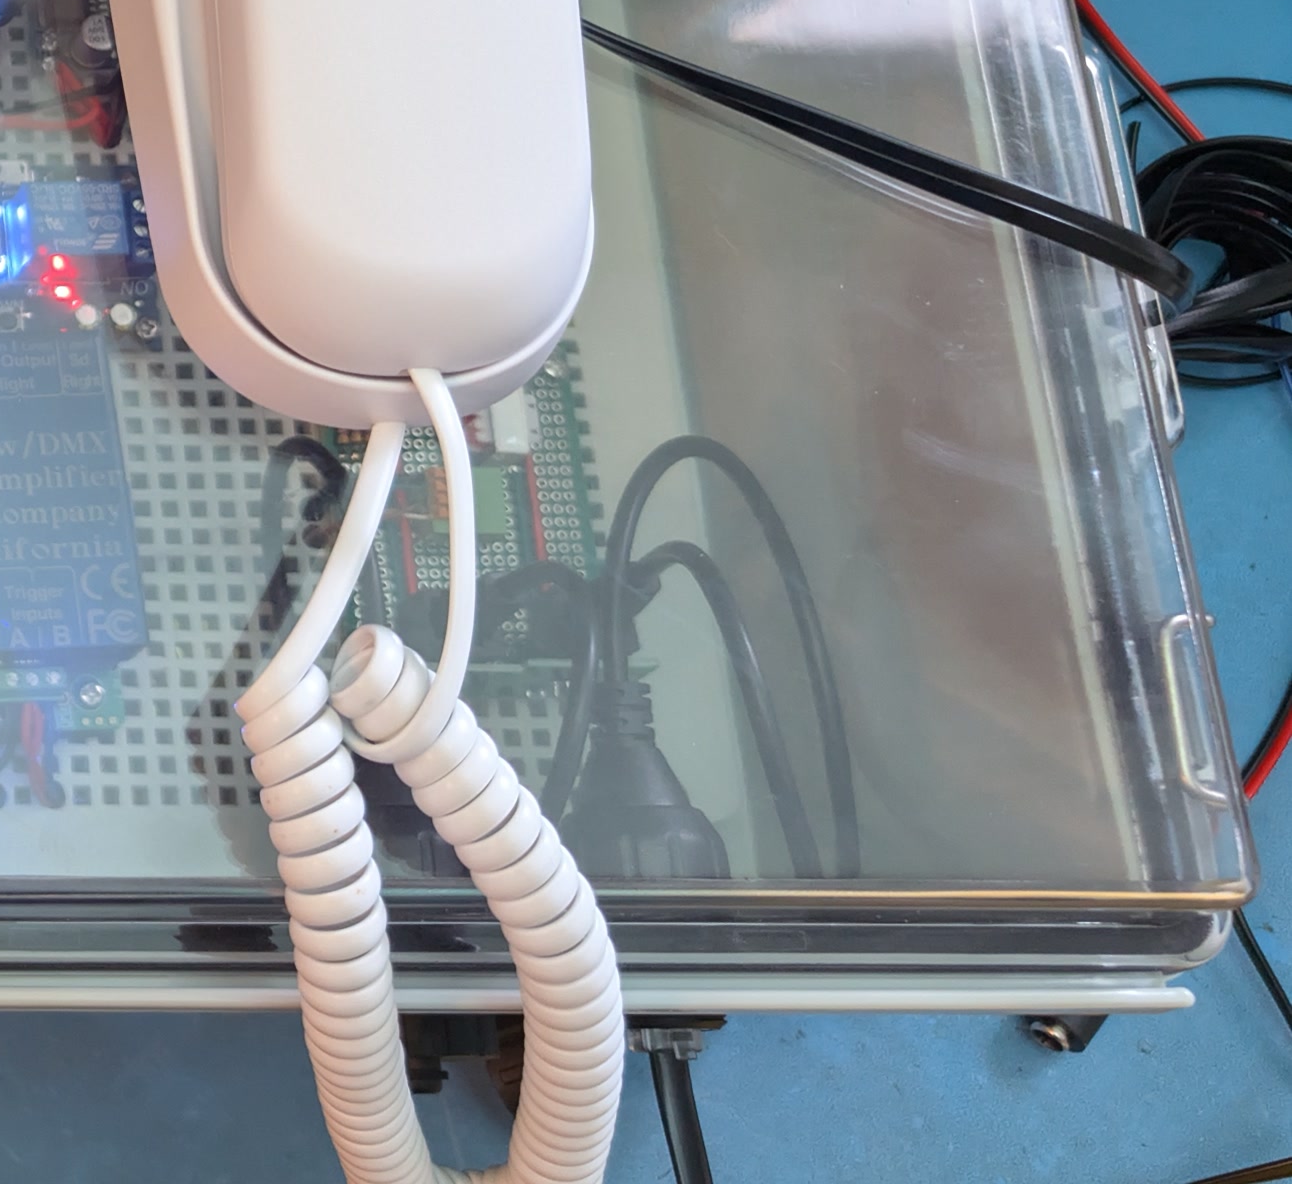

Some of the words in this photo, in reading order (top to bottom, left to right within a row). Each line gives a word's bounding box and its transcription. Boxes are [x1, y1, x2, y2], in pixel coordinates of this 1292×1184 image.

[120, 280, 150, 296] NO
[0, 353, 57, 369] Output
[4, 585, 65, 602] Trigger
[8, 627, 31, 649] A
[52, 625, 72, 647] B
